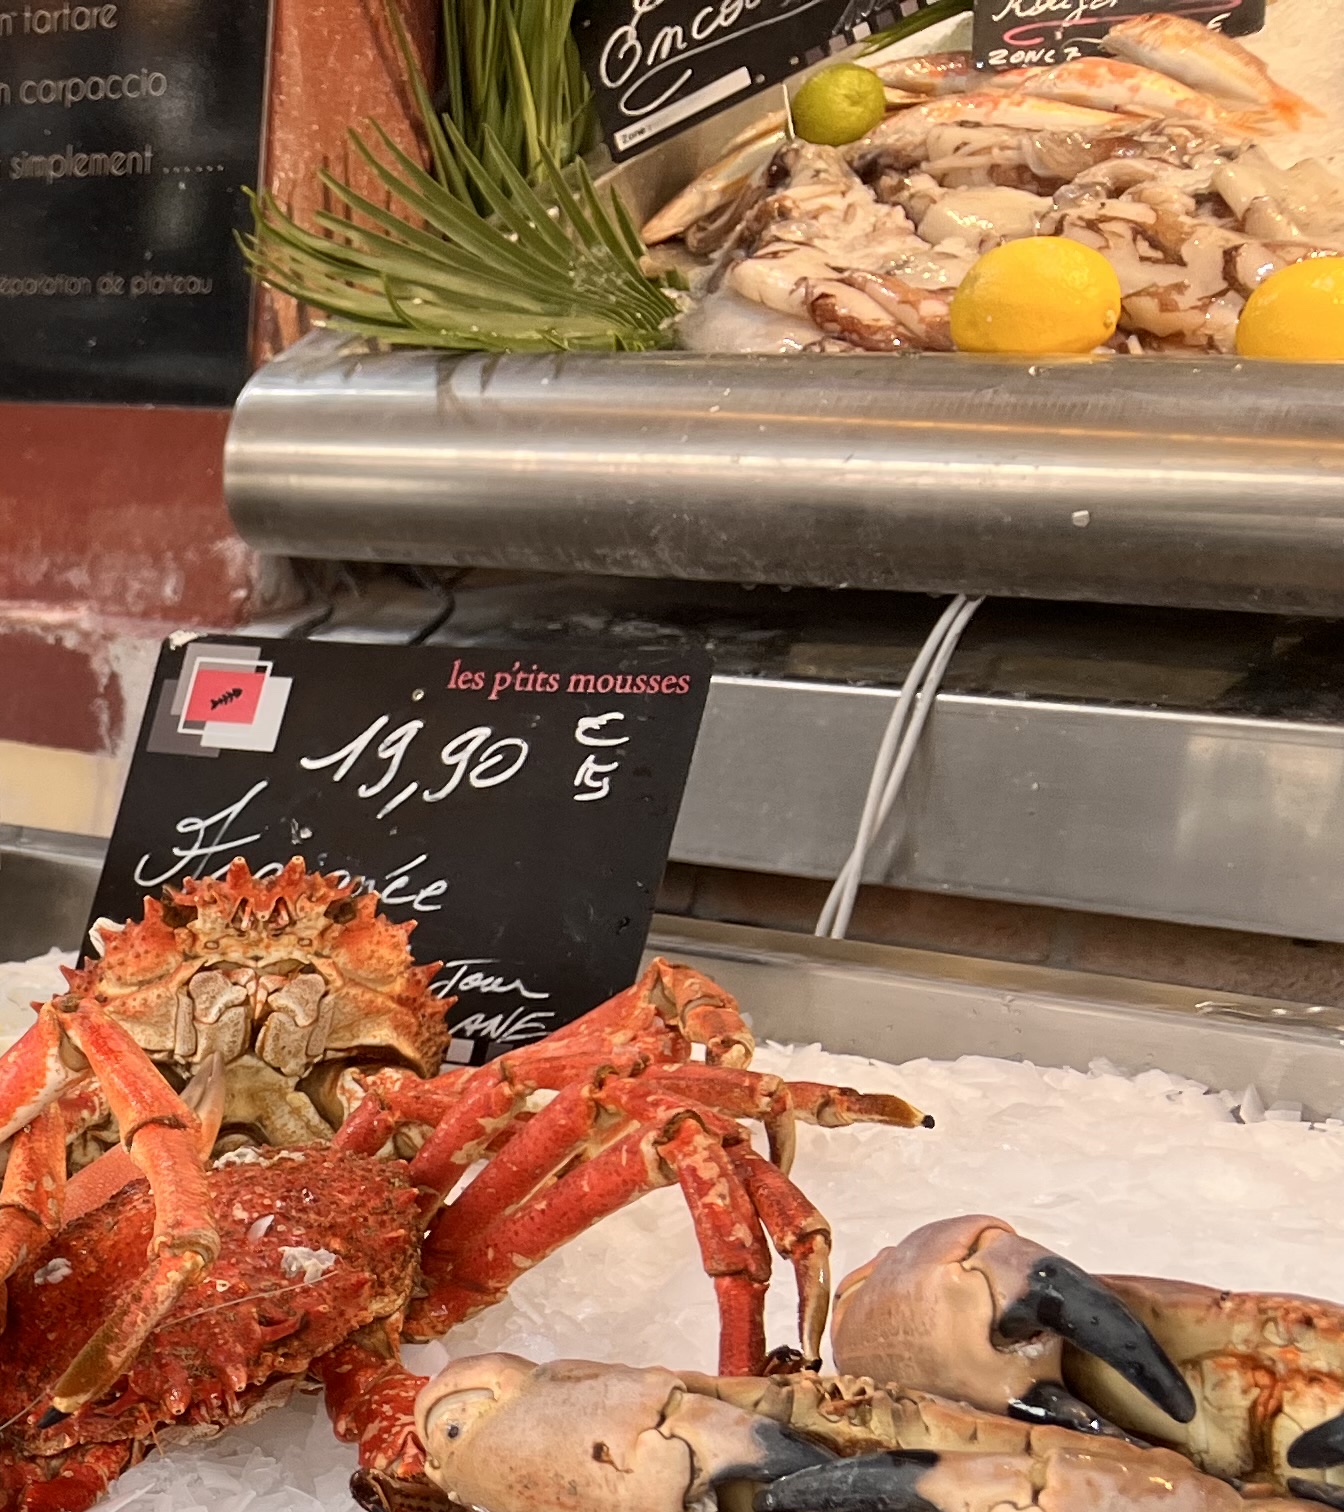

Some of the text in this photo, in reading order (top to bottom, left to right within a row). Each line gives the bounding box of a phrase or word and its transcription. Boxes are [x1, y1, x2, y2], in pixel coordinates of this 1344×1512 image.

[24, 3, 118, 32] tartare
[19, 68, 168, 109] carpaccio
[9, 144, 153, 185] simplement
[448, 659, 691, 700] les p'tits mousses
[299, 712, 530, 820] 19,90
